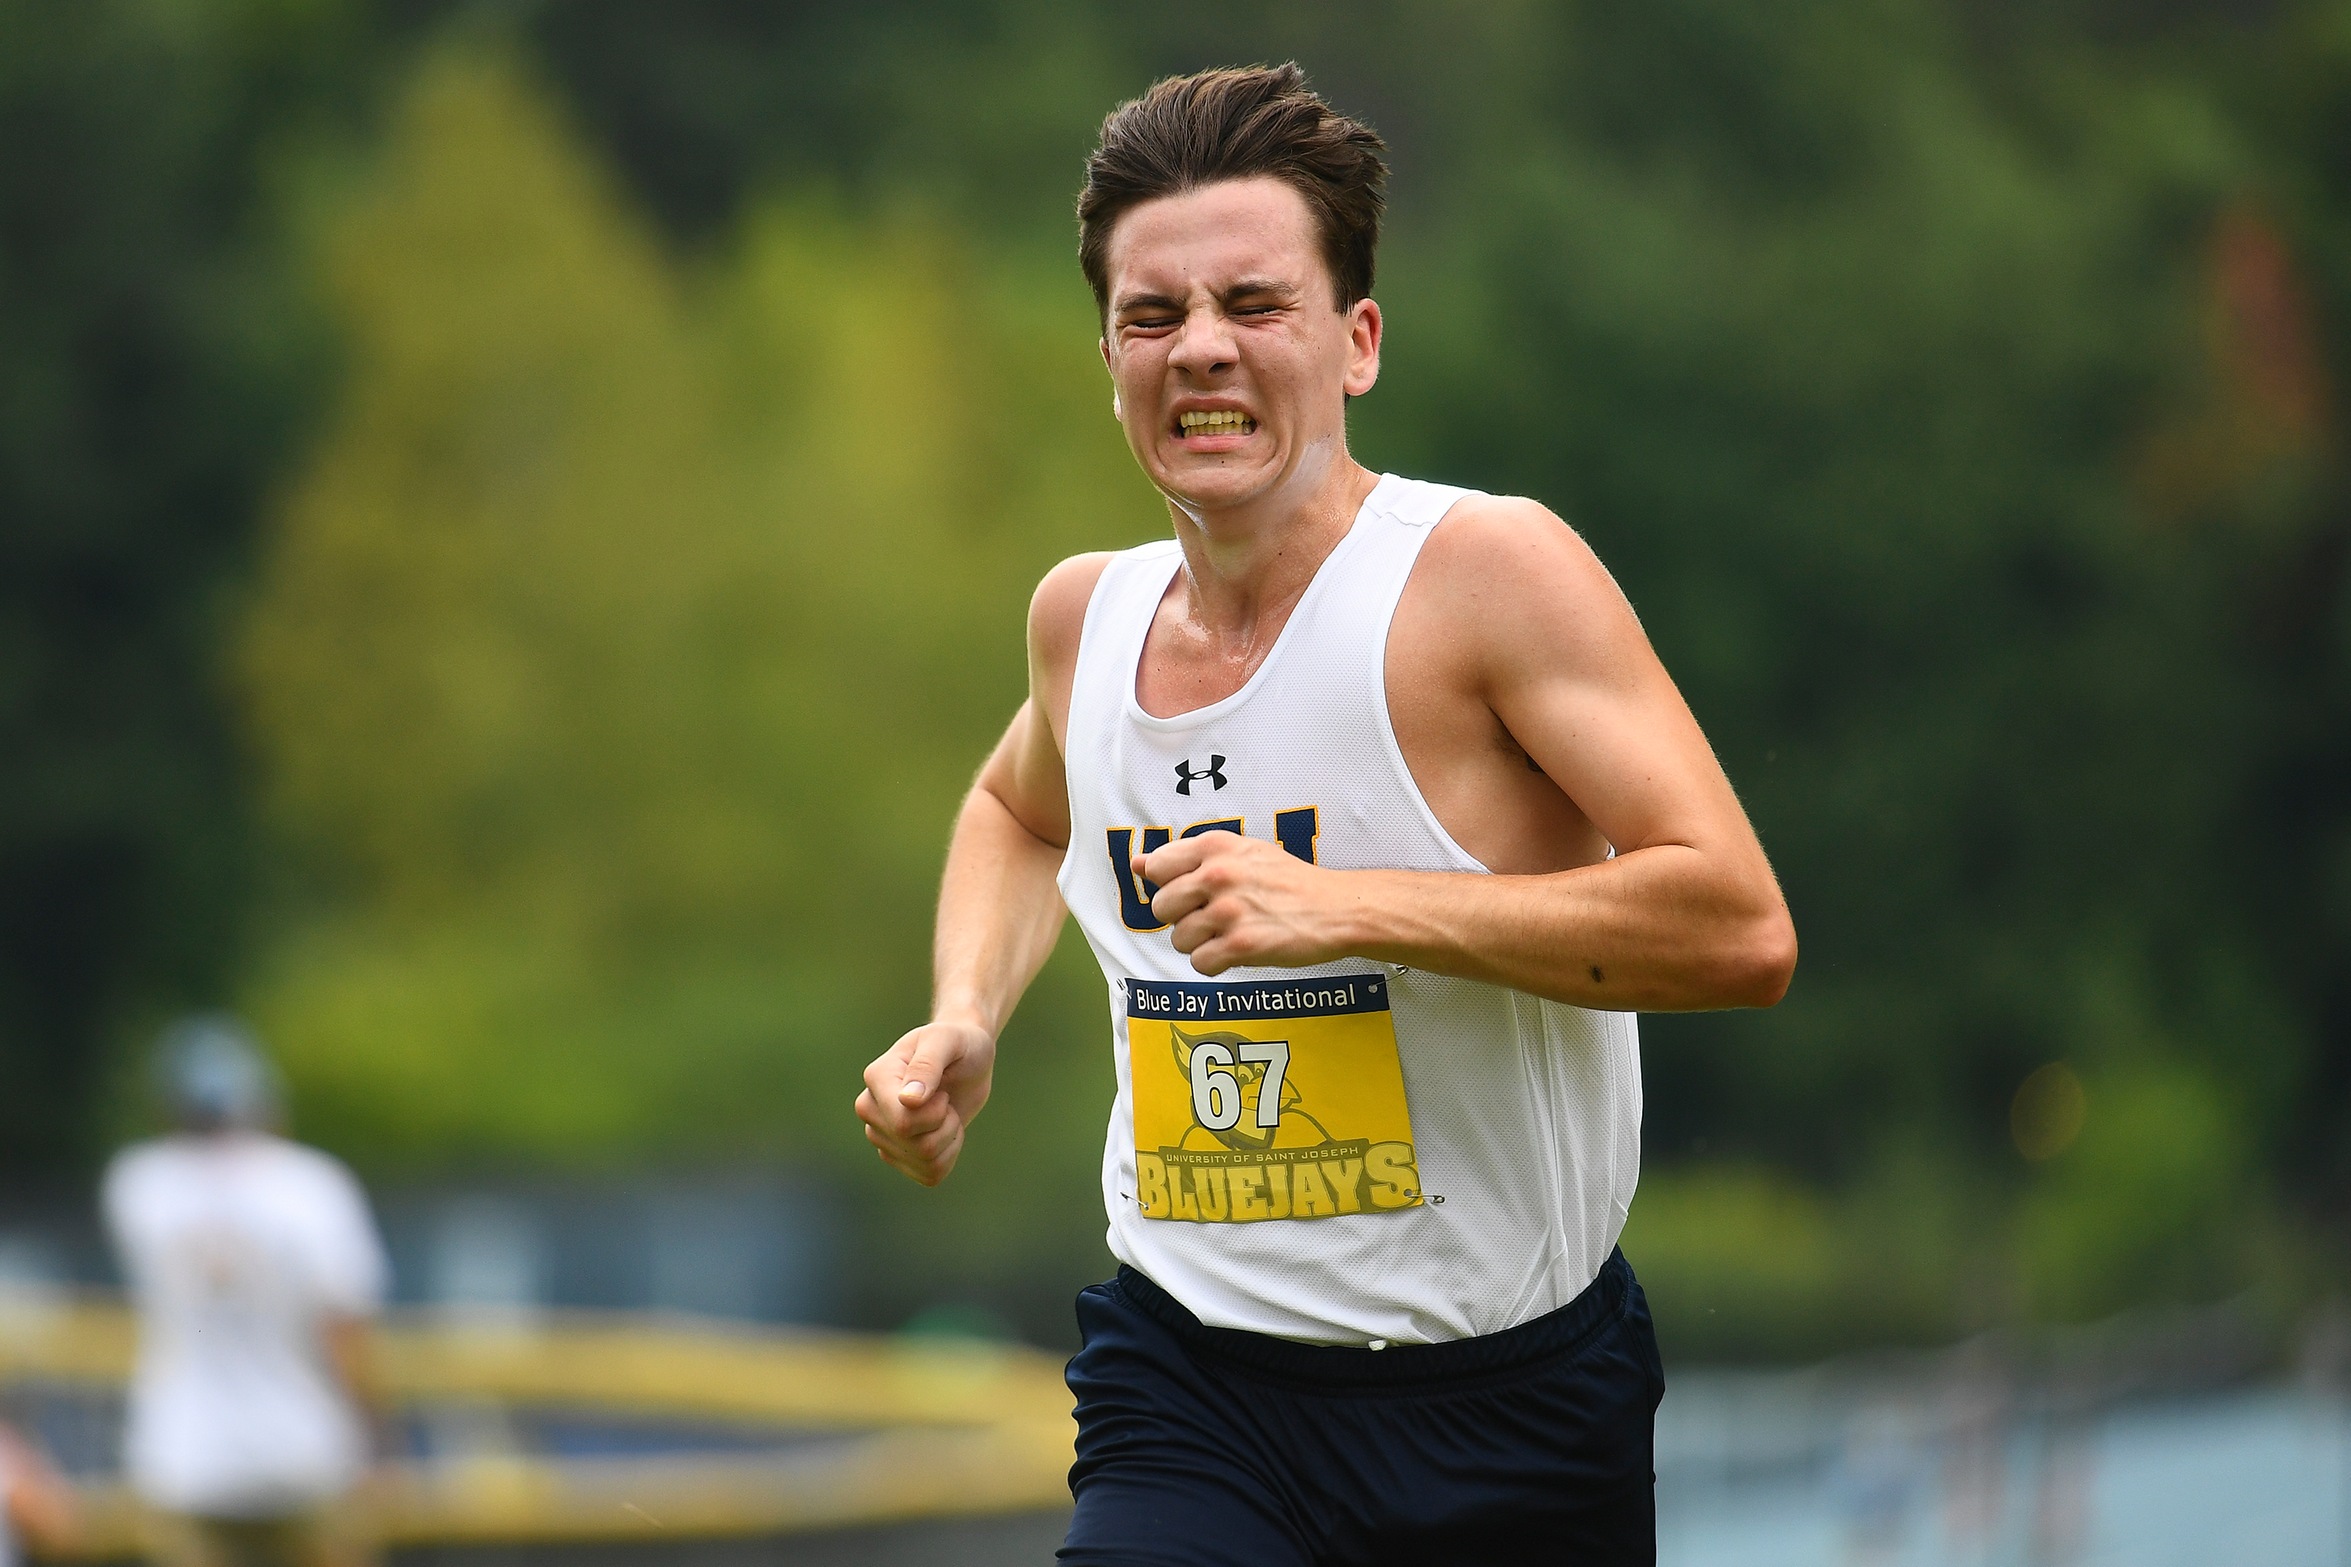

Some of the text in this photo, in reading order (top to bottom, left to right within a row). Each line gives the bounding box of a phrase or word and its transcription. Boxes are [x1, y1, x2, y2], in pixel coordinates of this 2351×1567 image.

[1136, 983, 1356, 1017] Blue Jay Invitational
[1189, 1040, 1291, 1131] 67
[1136, 1141, 1420, 1221] BLUEJAYS
[1166, 1147, 1358, 1163] UNIVERSITY OF SAINT JOSEPH
